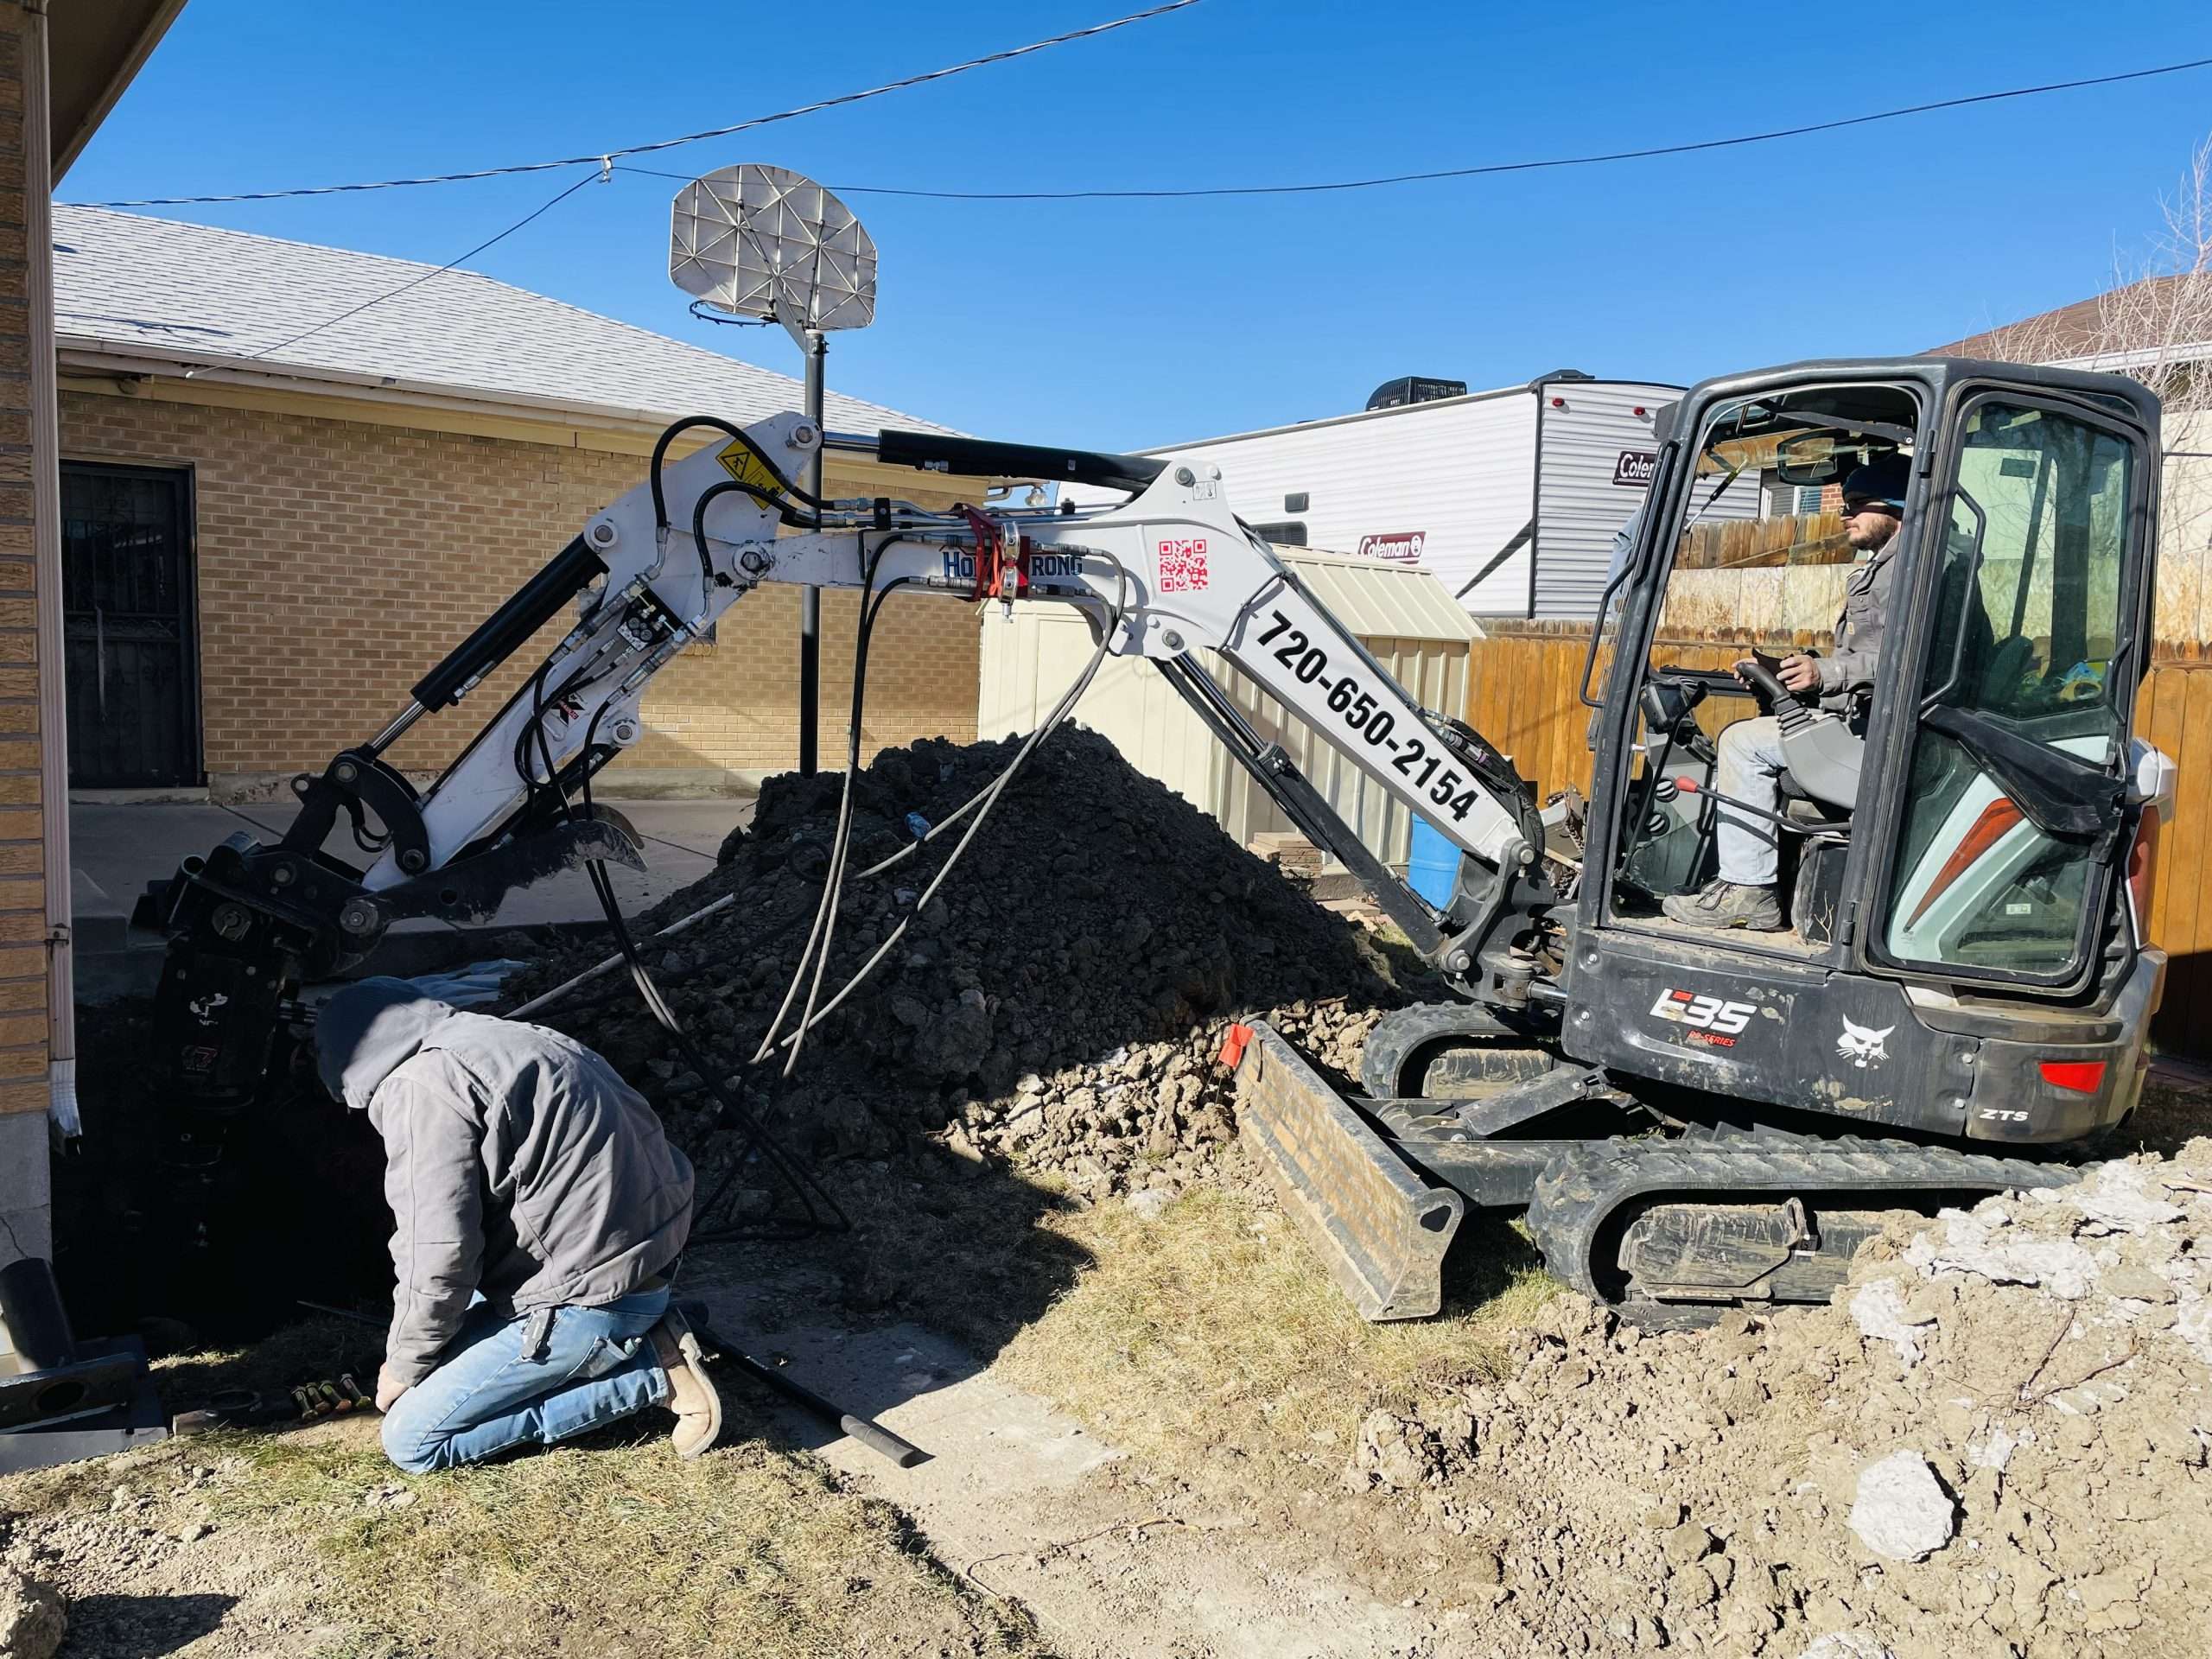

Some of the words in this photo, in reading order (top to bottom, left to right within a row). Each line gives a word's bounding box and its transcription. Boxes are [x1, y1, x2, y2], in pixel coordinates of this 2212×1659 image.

[1360, 536, 1410, 557] Coleman
[1257, 609, 1479, 823] 720-650-2154
[1649, 988, 1758, 1034] E35
[1979, 1108, 2030, 1122] ZTS
